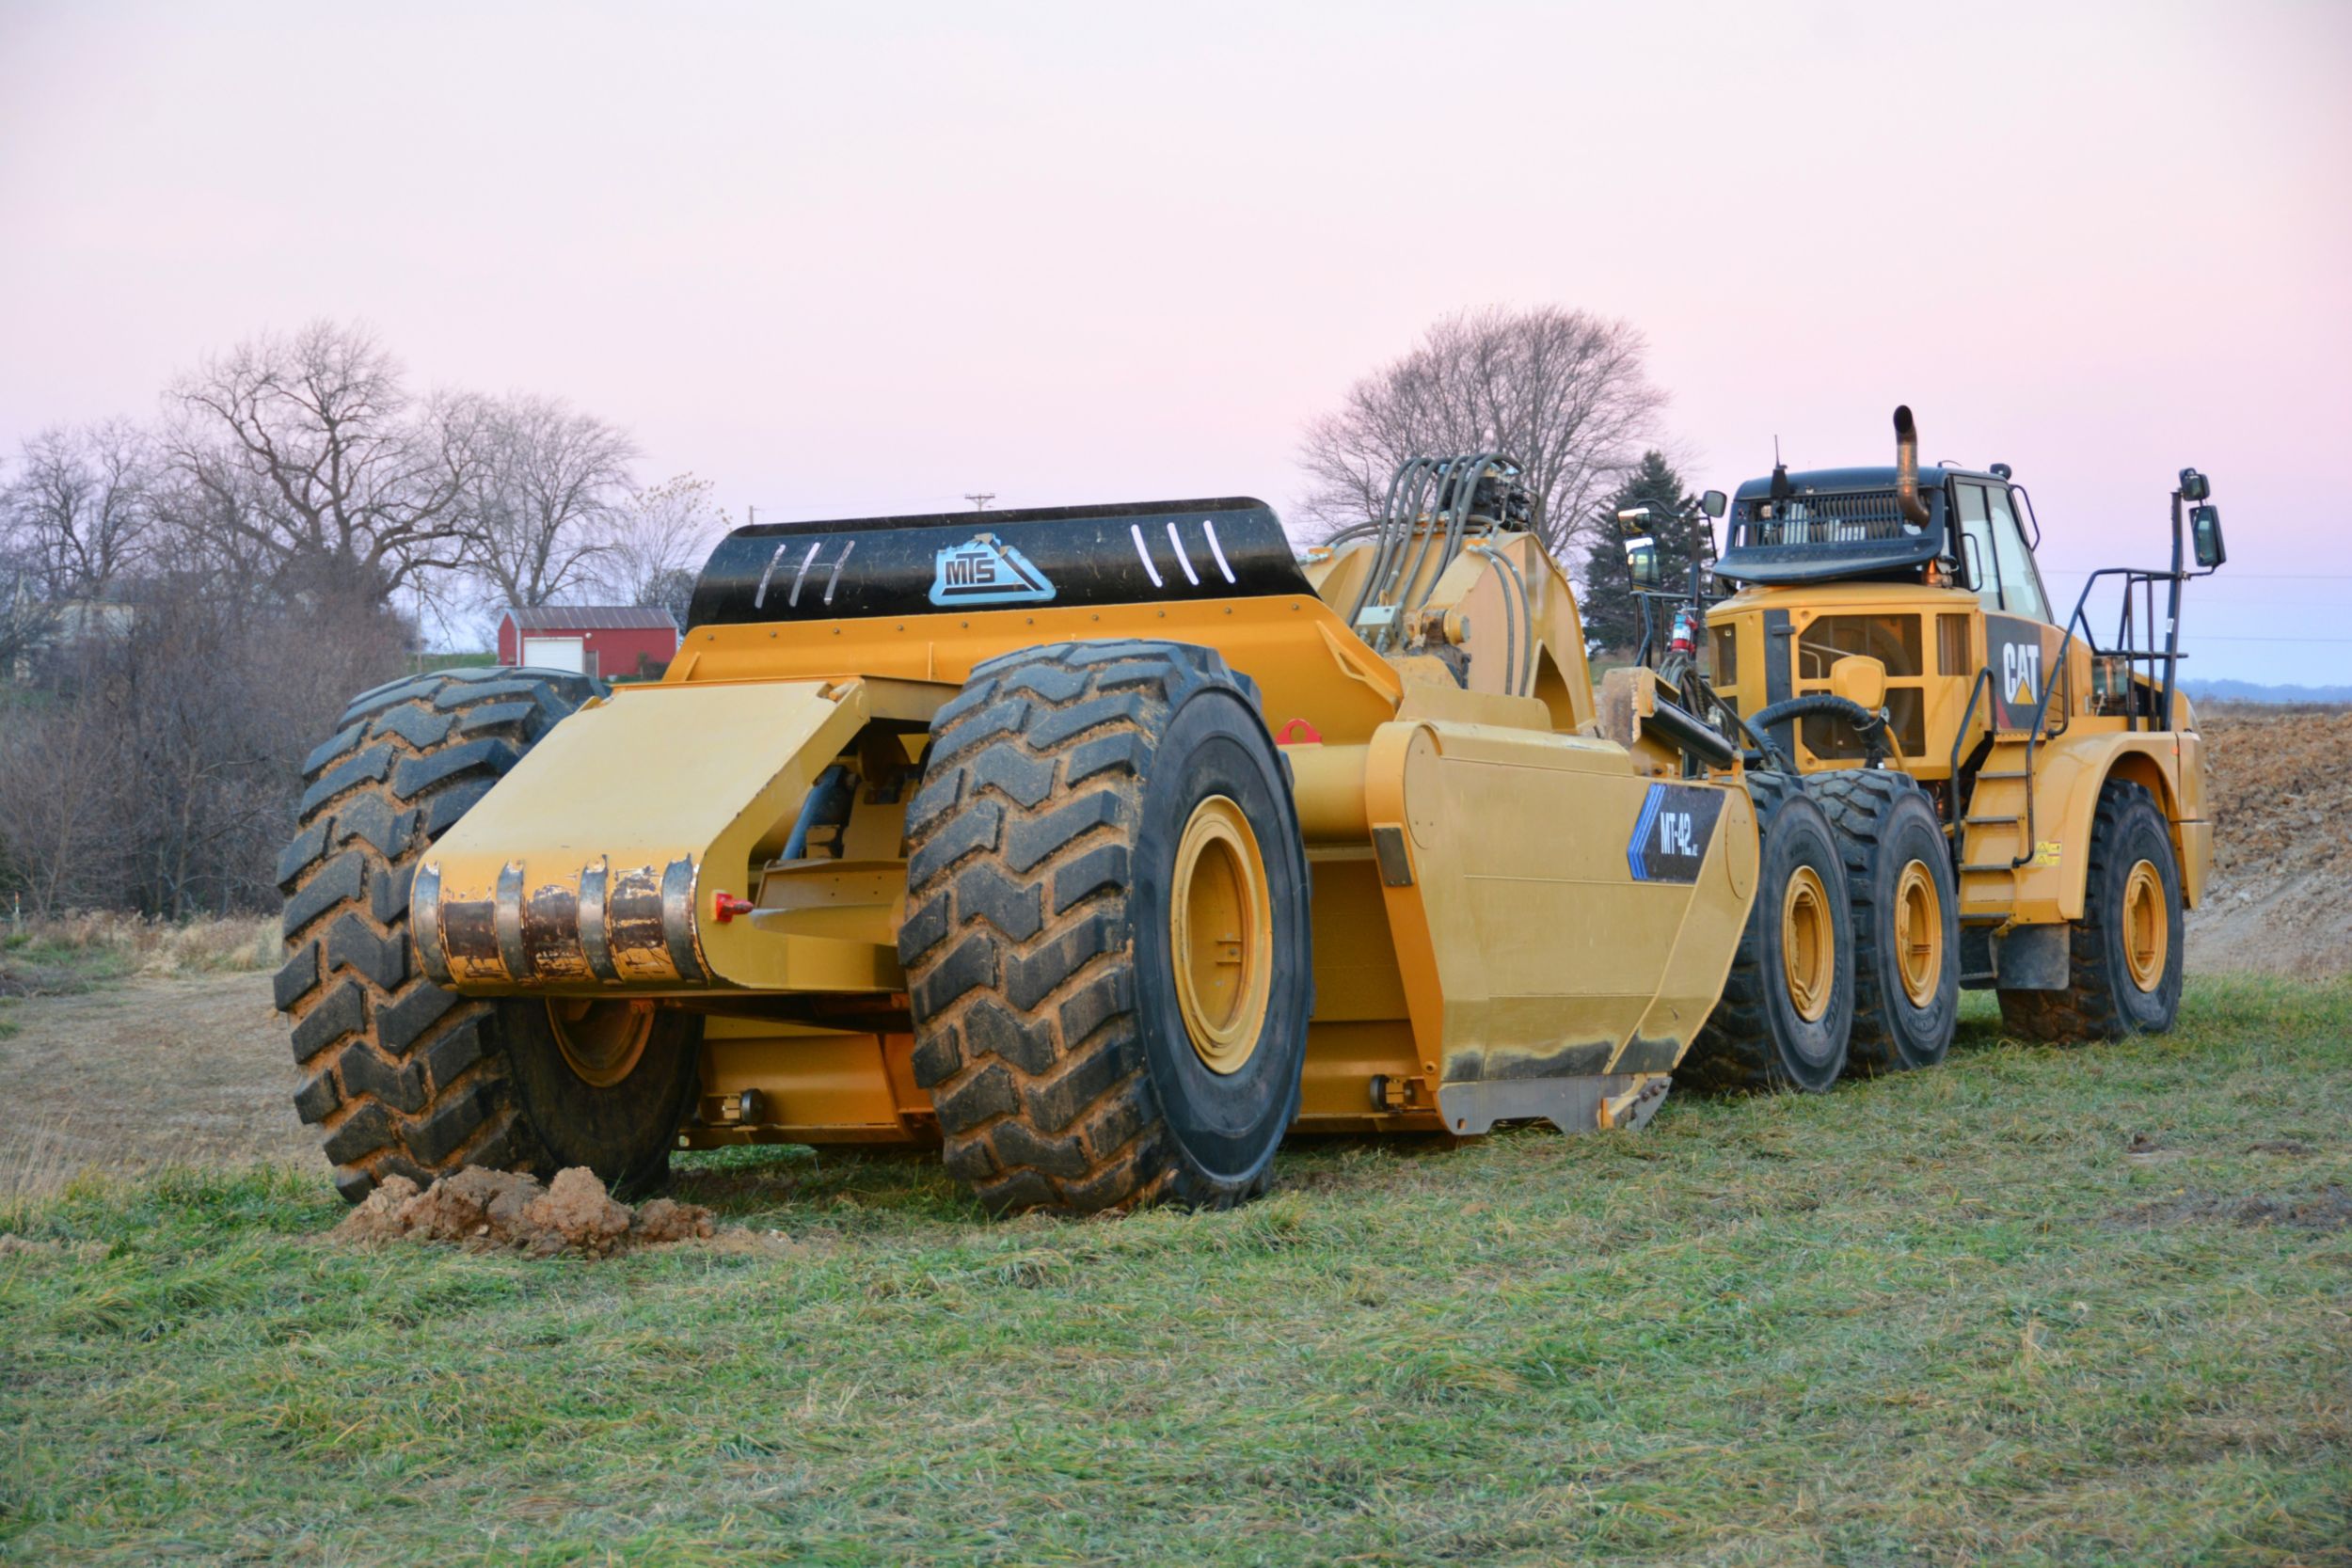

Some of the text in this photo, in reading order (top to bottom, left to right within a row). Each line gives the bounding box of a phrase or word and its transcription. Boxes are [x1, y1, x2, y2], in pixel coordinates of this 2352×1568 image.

[946, 552, 994, 584] MTS
[2003, 642, 2039, 705] CAT
[1661, 812, 1692, 855] MT-42
